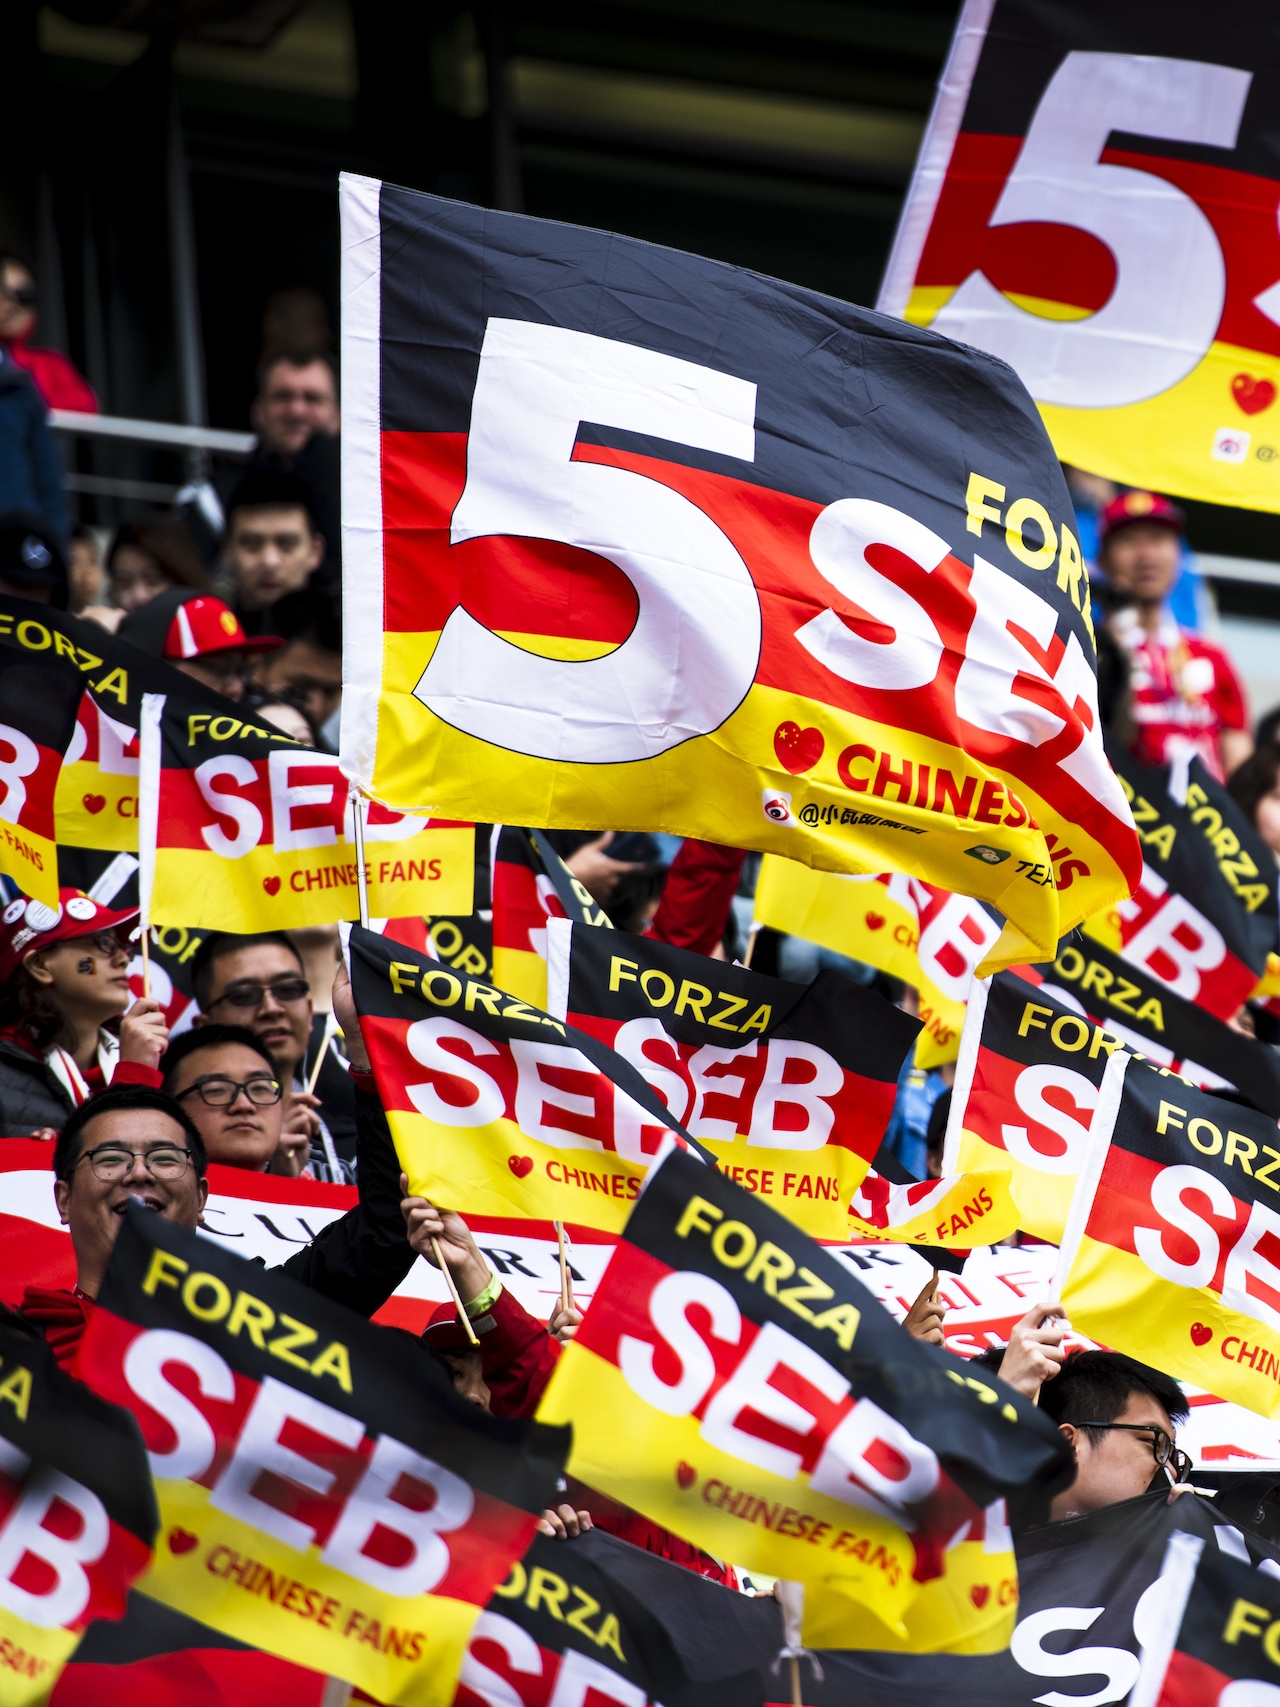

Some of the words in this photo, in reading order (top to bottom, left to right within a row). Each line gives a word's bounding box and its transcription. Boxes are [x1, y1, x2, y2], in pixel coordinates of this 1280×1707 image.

[926, 50, 1254, 411] 5
[412, 316, 762, 765] 5
[965, 471, 1098, 657] FOR
[836, 743, 1041, 831] CHINES
[3, 828, 45, 873] FANS
[379, 858, 442, 884] FANS
[608, 955, 773, 1034] FORZA
[1054, 946, 1166, 1032] ORZA
[614, 1017, 845, 1151] SEB
[545, 1160, 644, 1201] CHINES
[782, 1172, 840, 1202] FANS
[936, 1187, 994, 1240] FANS
[141, 1247, 354, 1395] FORZA
[675, 1195, 862, 1353] FORZA
[617, 1270, 941, 1533] SEB
[122, 1328, 475, 1599] SEB
[701, 1477, 833, 1550] CHINESE
[829, 1529, 903, 1588] FANS
[205, 1544, 342, 1622] CHINESE
[341, 1607, 428, 1663] FANS
[493, 1560, 629, 1665] ORZA
